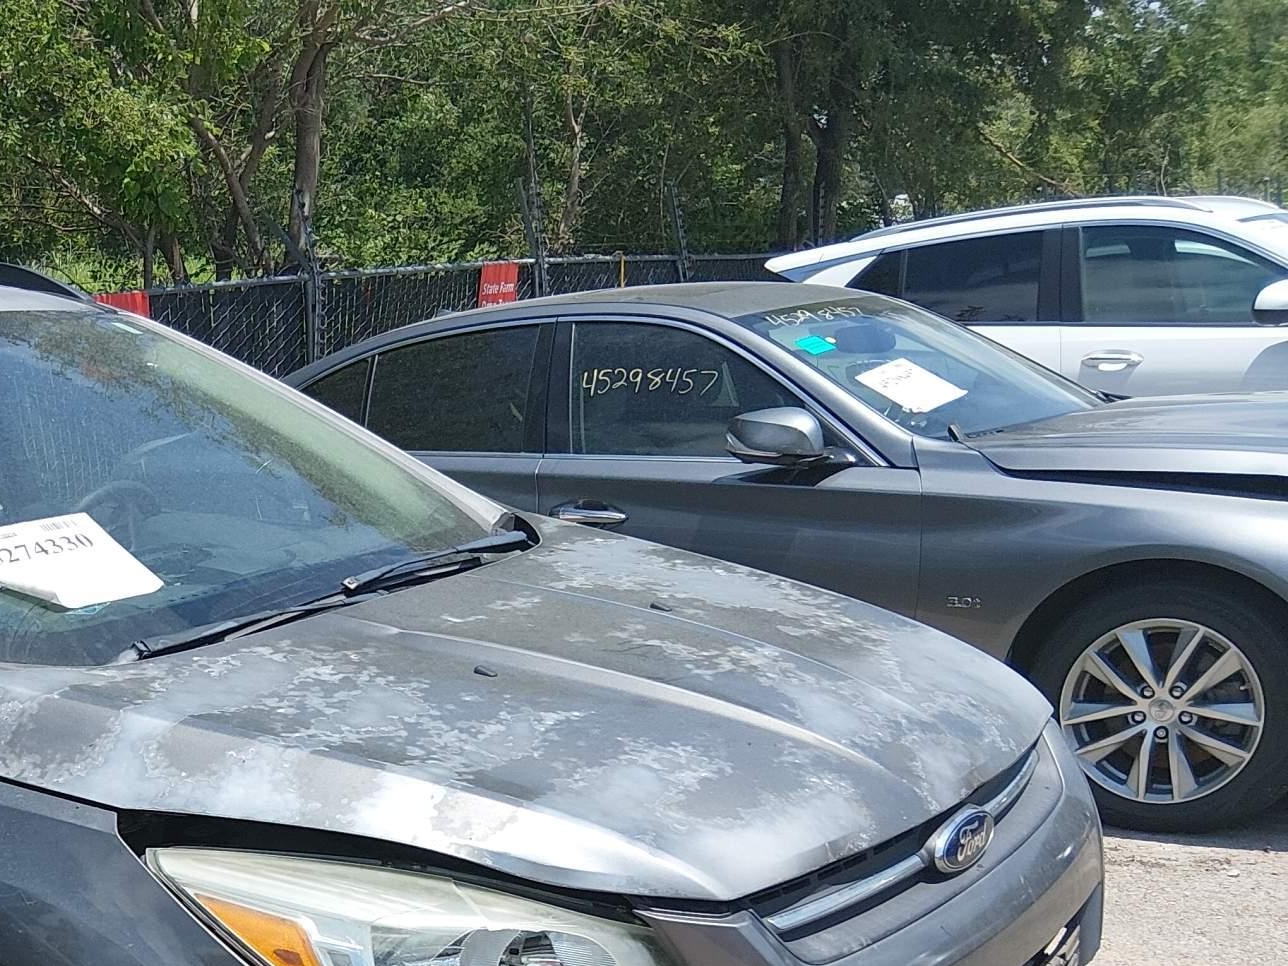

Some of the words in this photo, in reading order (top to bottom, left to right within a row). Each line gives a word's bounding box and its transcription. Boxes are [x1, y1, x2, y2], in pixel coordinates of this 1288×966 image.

[481, 283, 499, 296] State
[499, 281, 515, 294] Farm
[582, 367, 719, 397] 45298457
[957, 819, 988, 862] Ford
